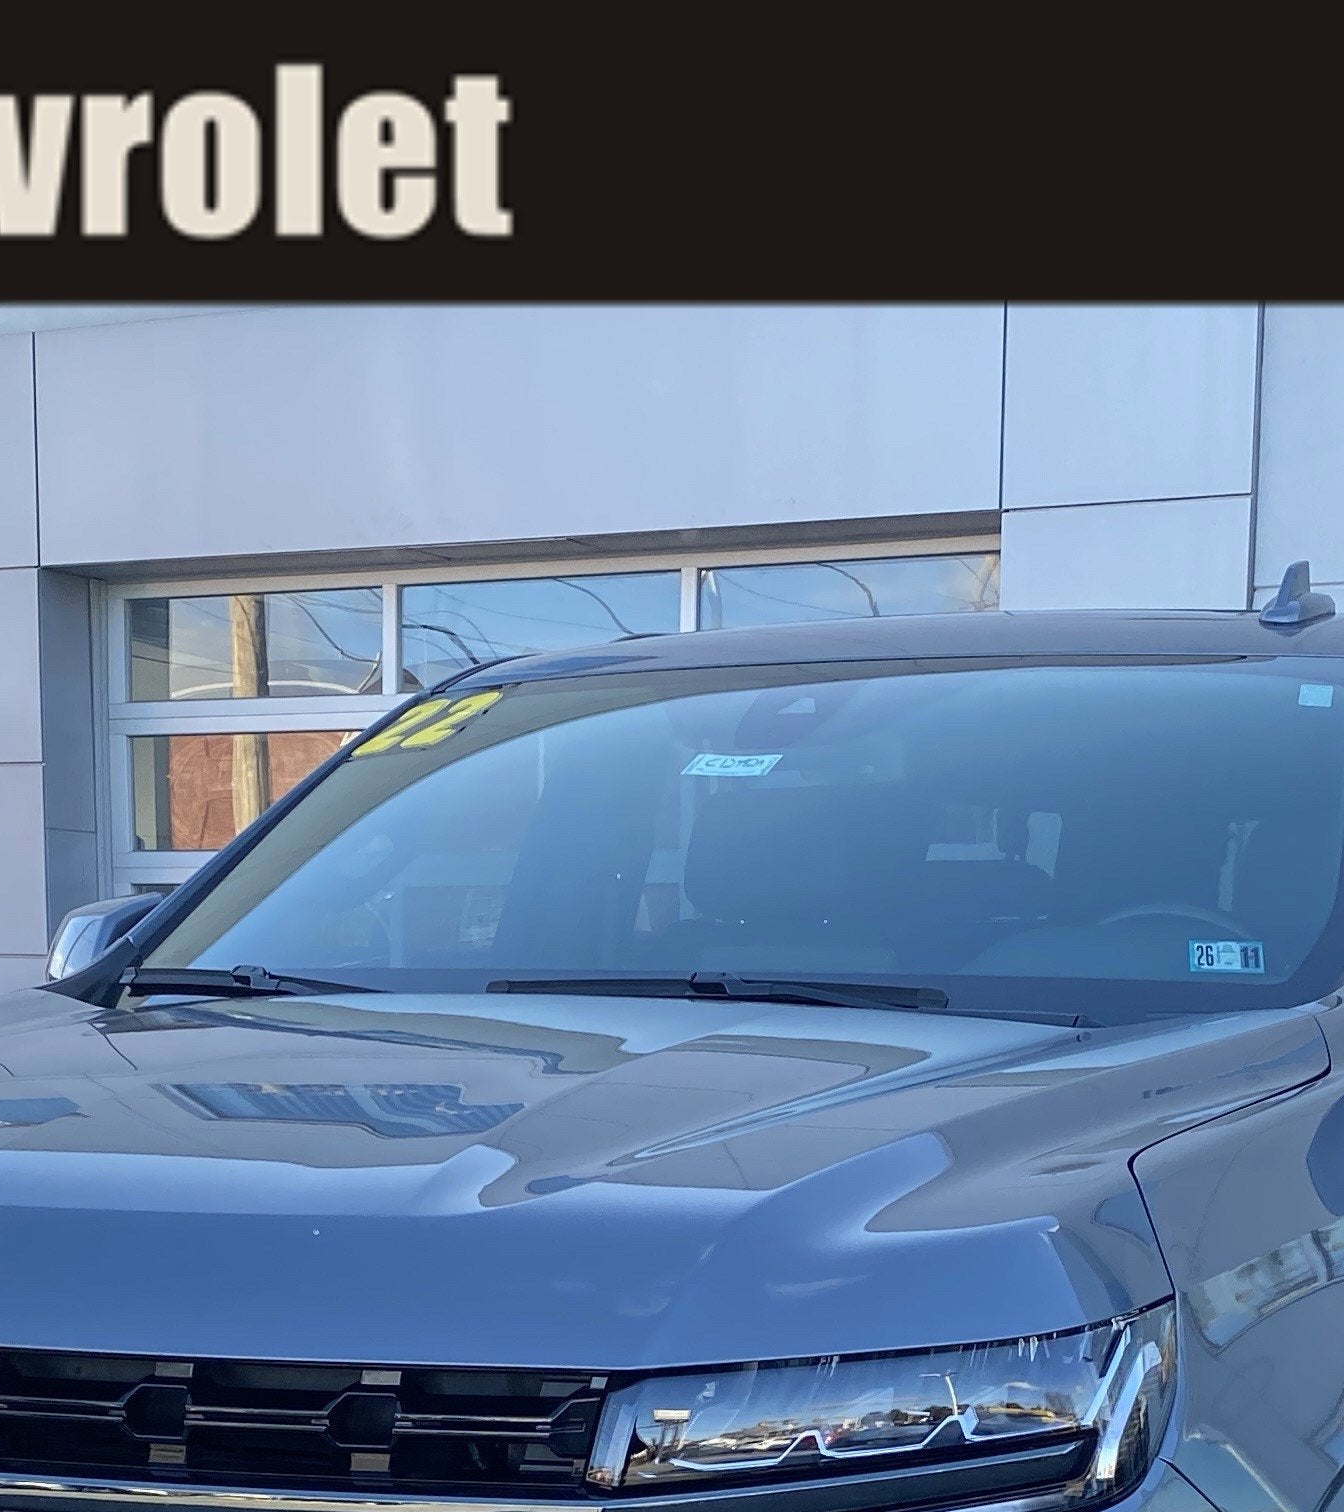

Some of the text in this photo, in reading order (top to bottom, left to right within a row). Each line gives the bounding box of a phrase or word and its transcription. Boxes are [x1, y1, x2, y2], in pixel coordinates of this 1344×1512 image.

[350, 690, 504, 758] 22
[1196, 944, 1214, 967] 26
[1240, 945, 1261, 969] 11
